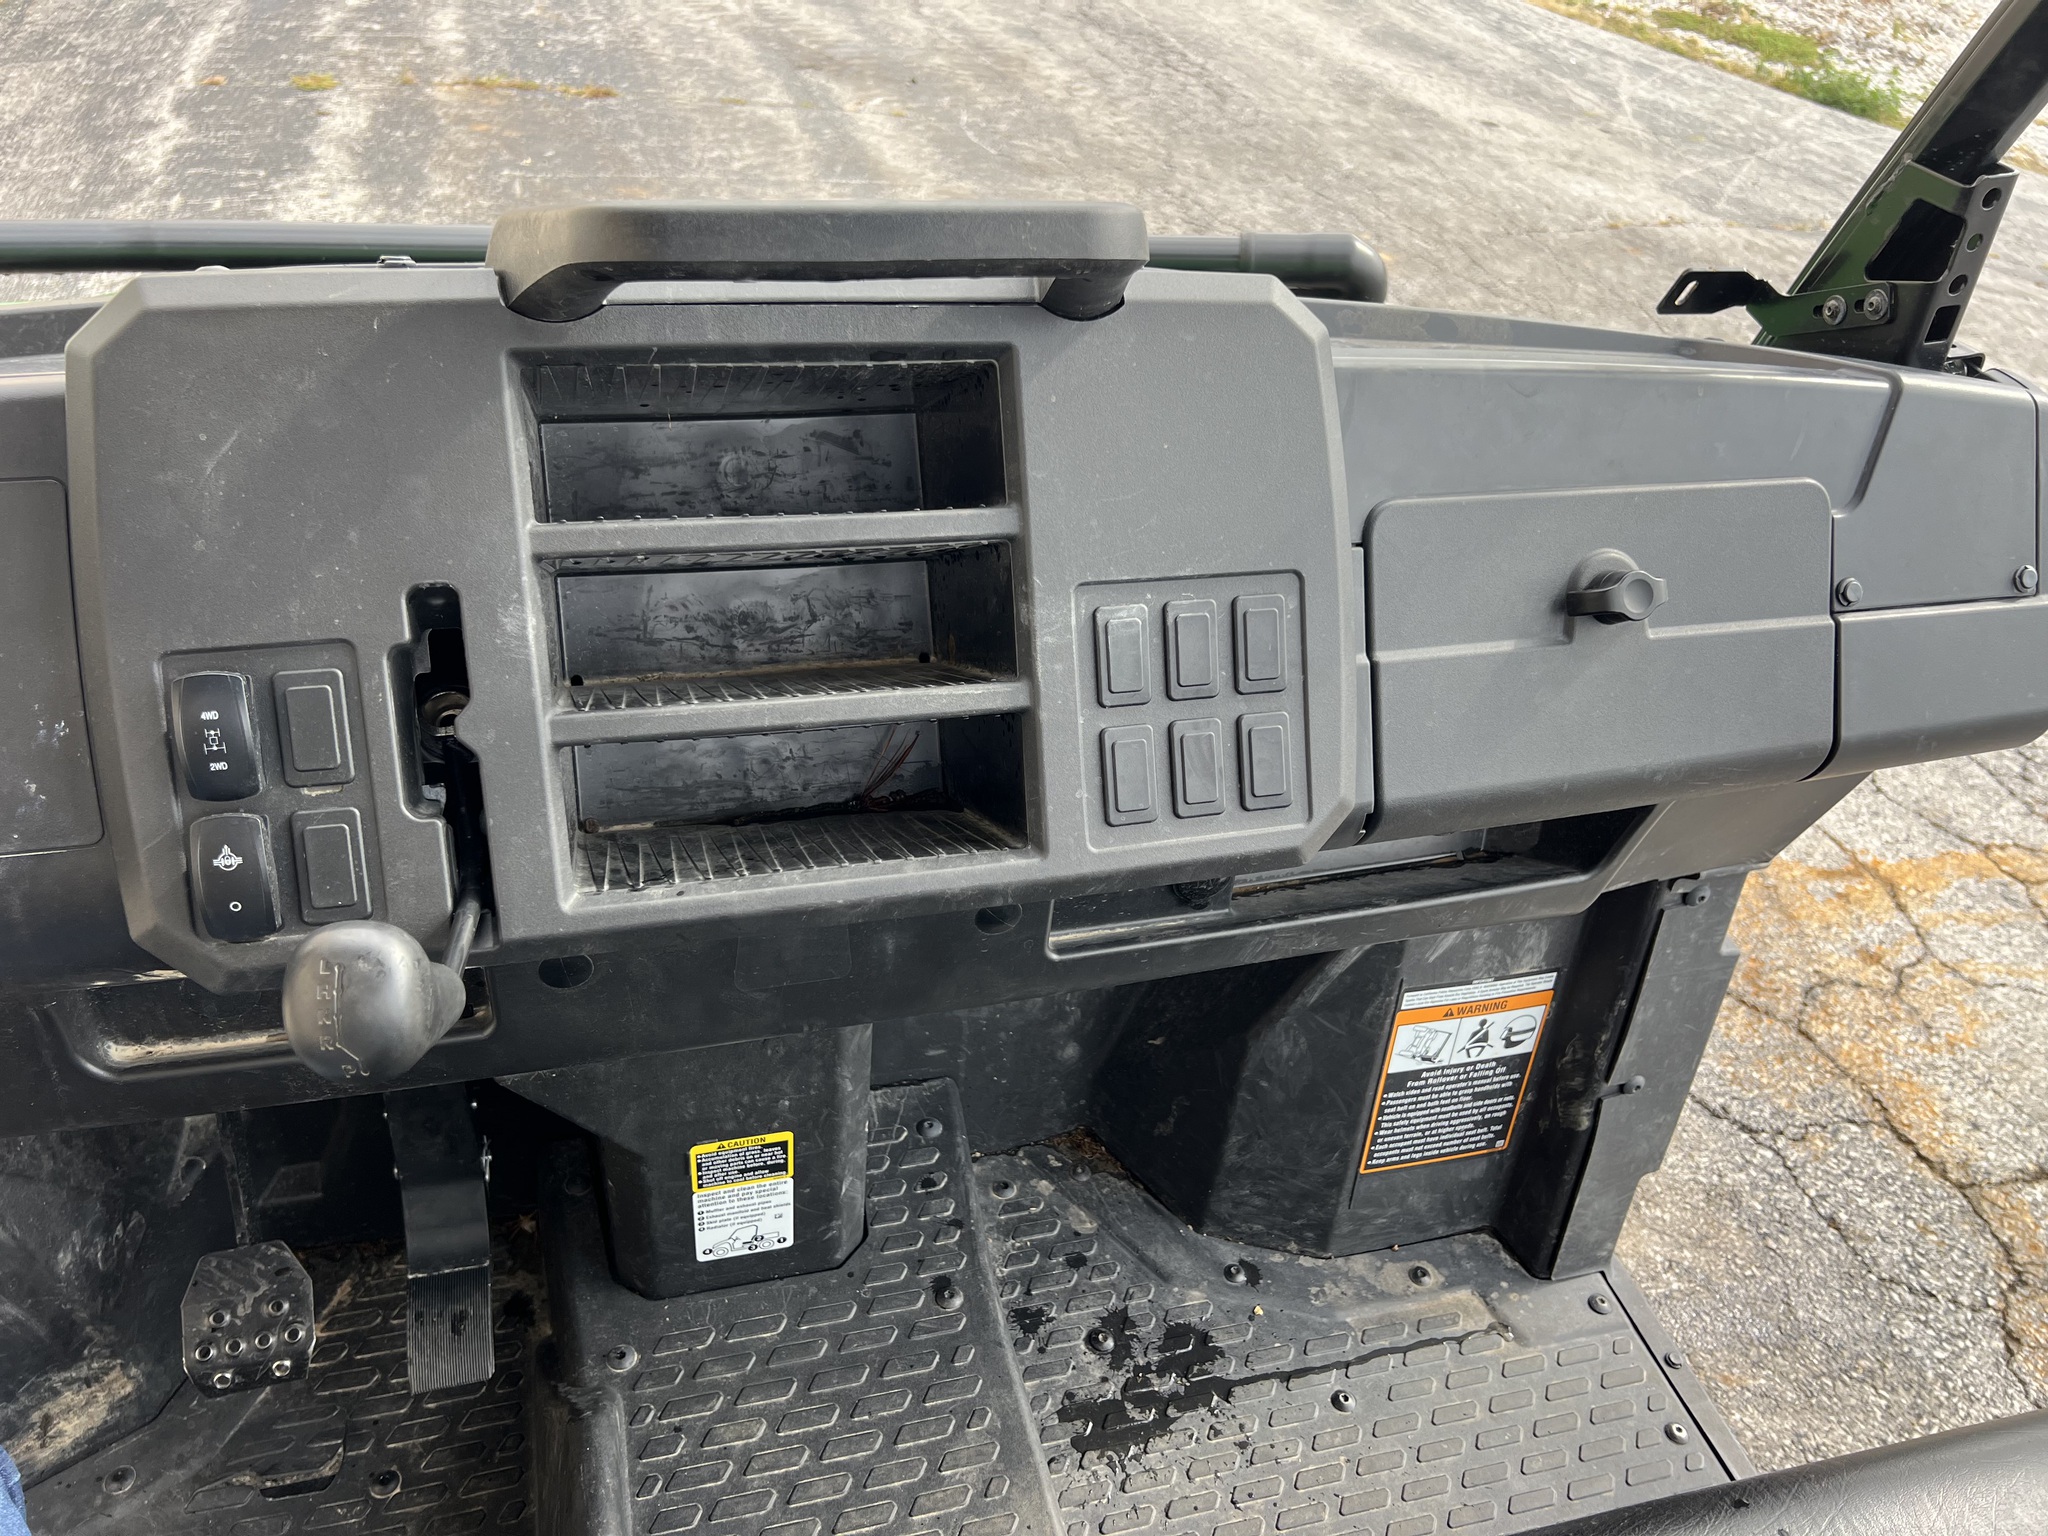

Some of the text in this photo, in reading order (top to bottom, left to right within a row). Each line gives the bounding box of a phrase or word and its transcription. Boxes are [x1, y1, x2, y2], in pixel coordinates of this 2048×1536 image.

[200, 710, 219, 721] 4WD
[209, 761, 228, 771] 2WD
[319, 959, 331, 975] L
[1456, 1001, 1508, 1016] WARNING
[1421, 1069, 1442, 1078] Avoid
[1442, 1066, 1465, 1076] Injury
[1475, 1061, 1497, 1070] Death
[1407, 1079, 1427, 1088] From
[1427, 1074, 1458, 1084] Rollover
[1468, 1068, 1494, 1079] Falling
[1495, 1066, 1507, 1074] Off
[728, 1137, 766, 1148] CAUTION
[697, 1191, 721, 1199] Inspect
[698, 1195, 725, 1203] machine
[755, 1186, 778, 1194] special
[698, 1200, 727, 1209] attention
